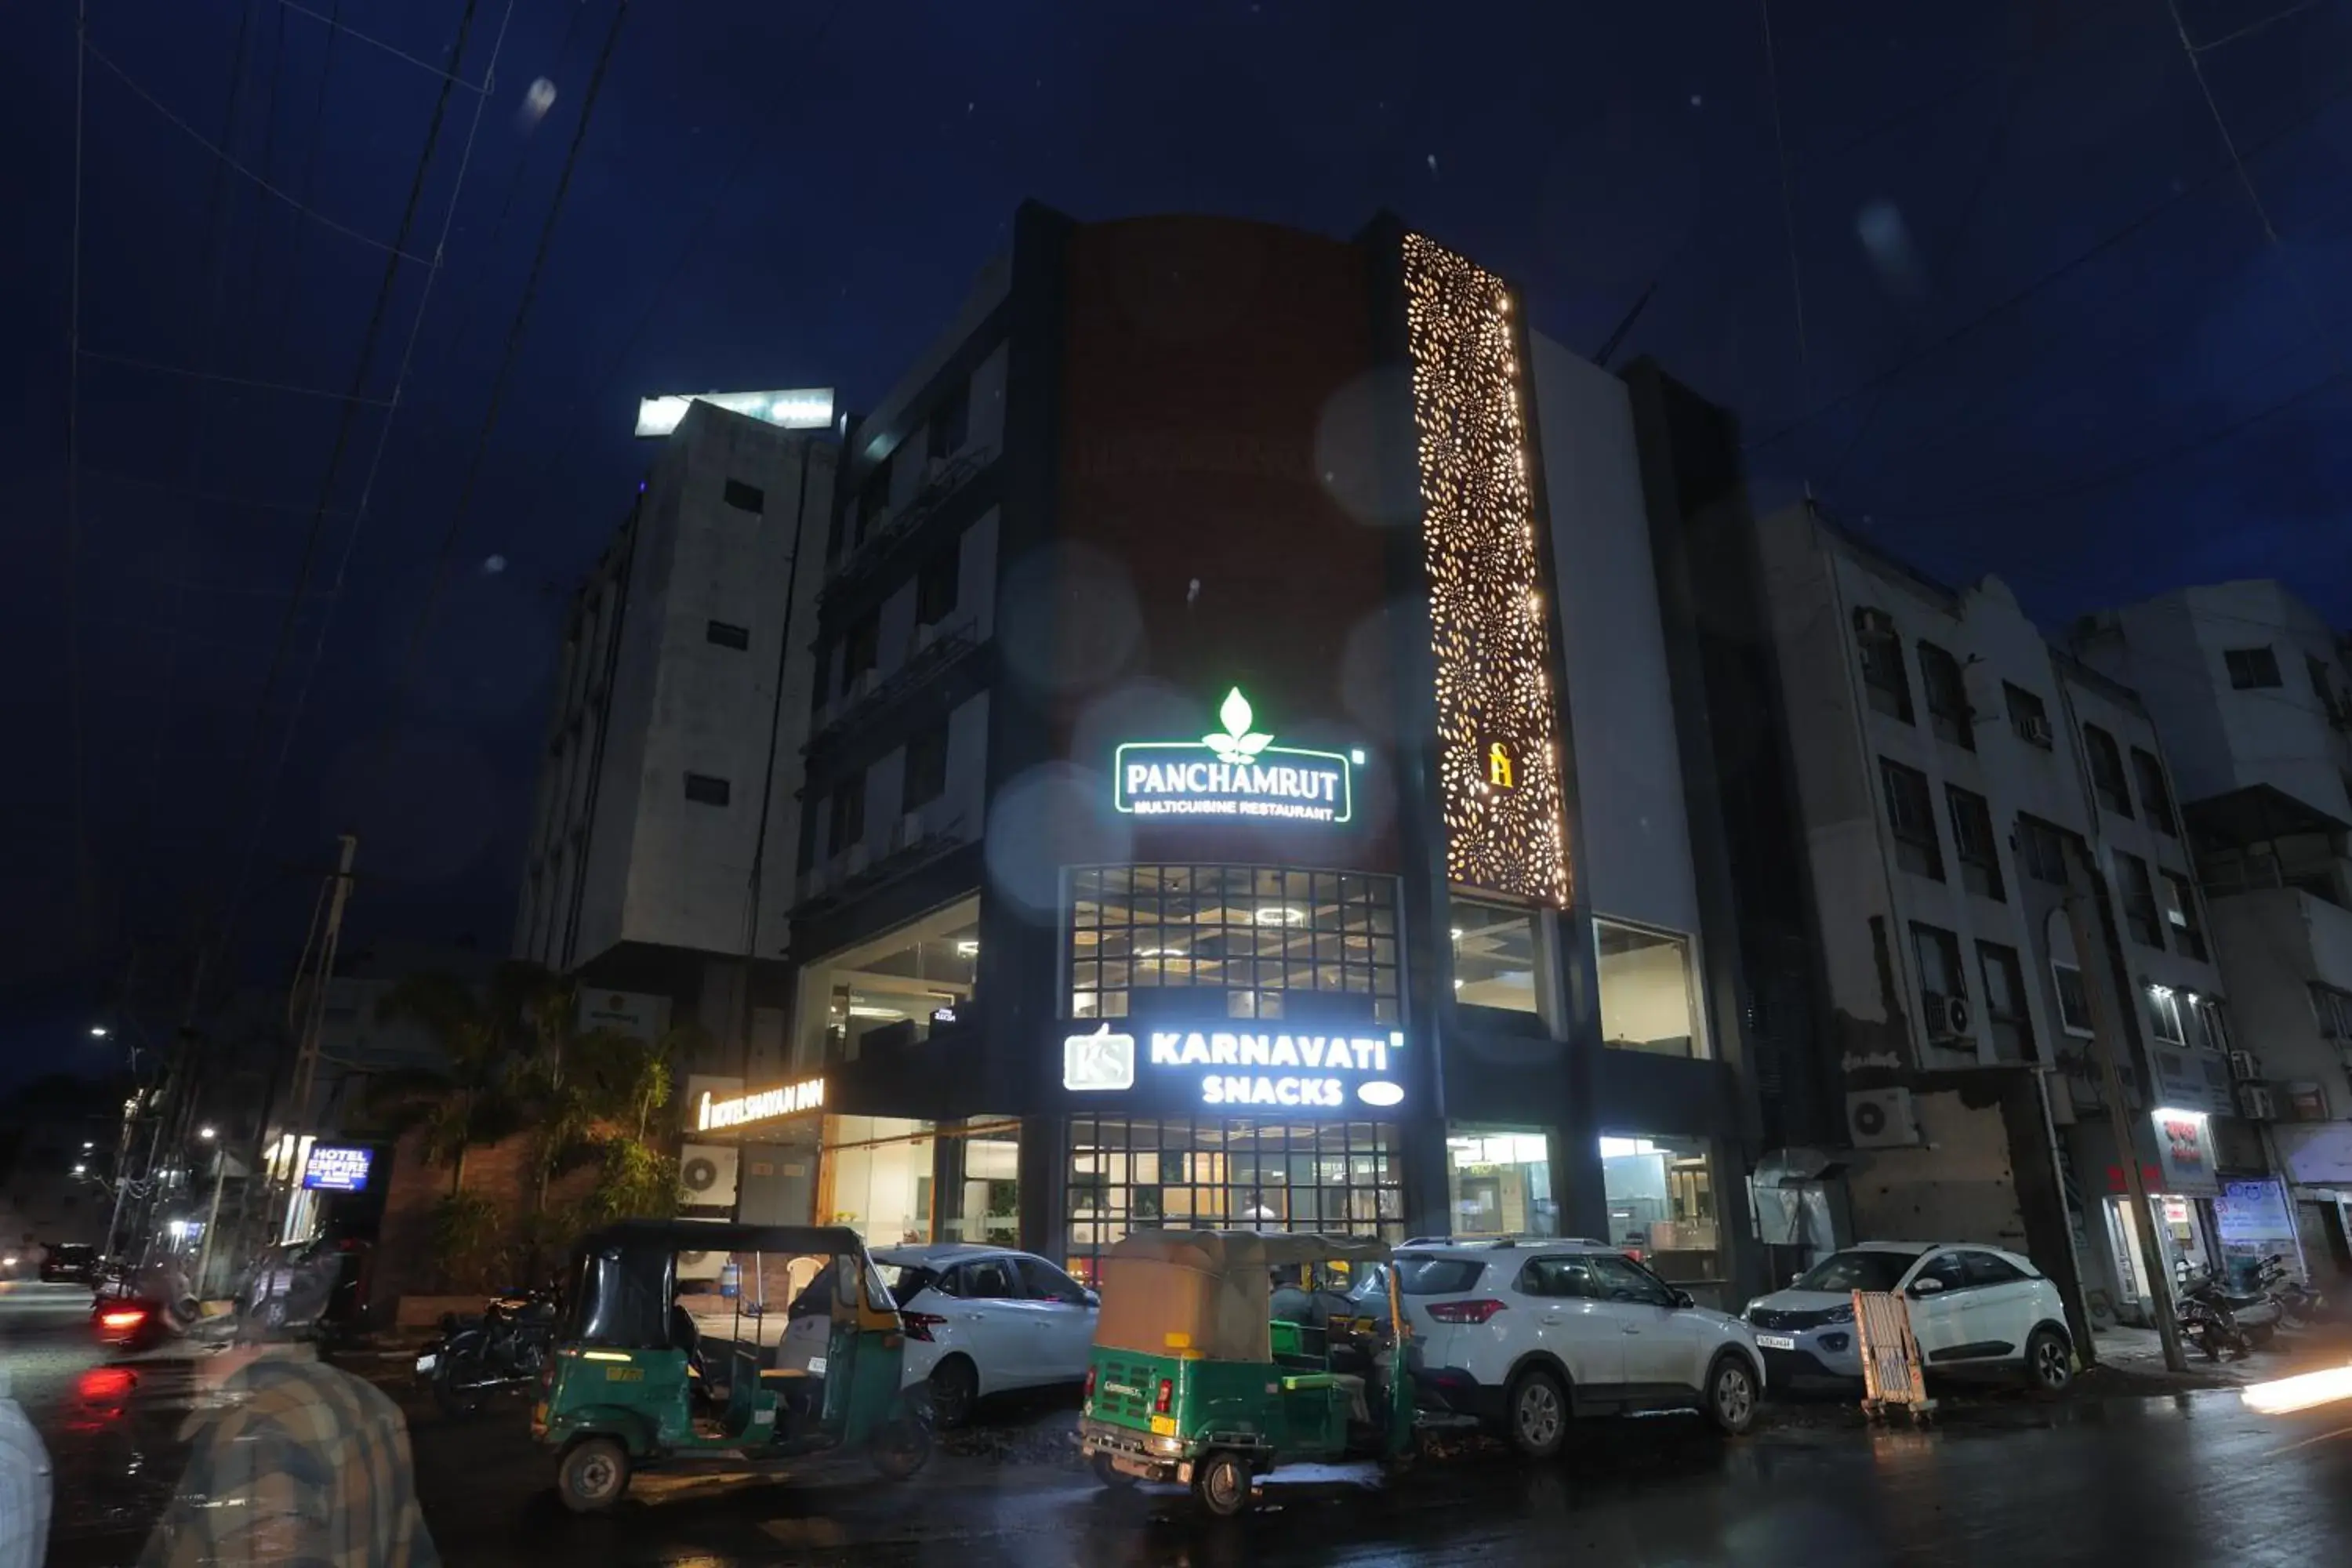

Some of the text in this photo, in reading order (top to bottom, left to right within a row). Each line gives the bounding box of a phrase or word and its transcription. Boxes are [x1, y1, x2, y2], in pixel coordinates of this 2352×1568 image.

[1127, 762, 1338, 801] PANCHAMRUT
[1134, 800, 1333, 821] MULTICUISINE RESTAURANT
[1076, 1041, 1124, 1083] KS
[1151, 1032, 1387, 1070] KARNAVATI
[1202, 1075, 1343, 1106] SNACKS
[307, 1160, 369, 1172] EMPIRE
[313, 1149, 367, 1162] HOTEL
